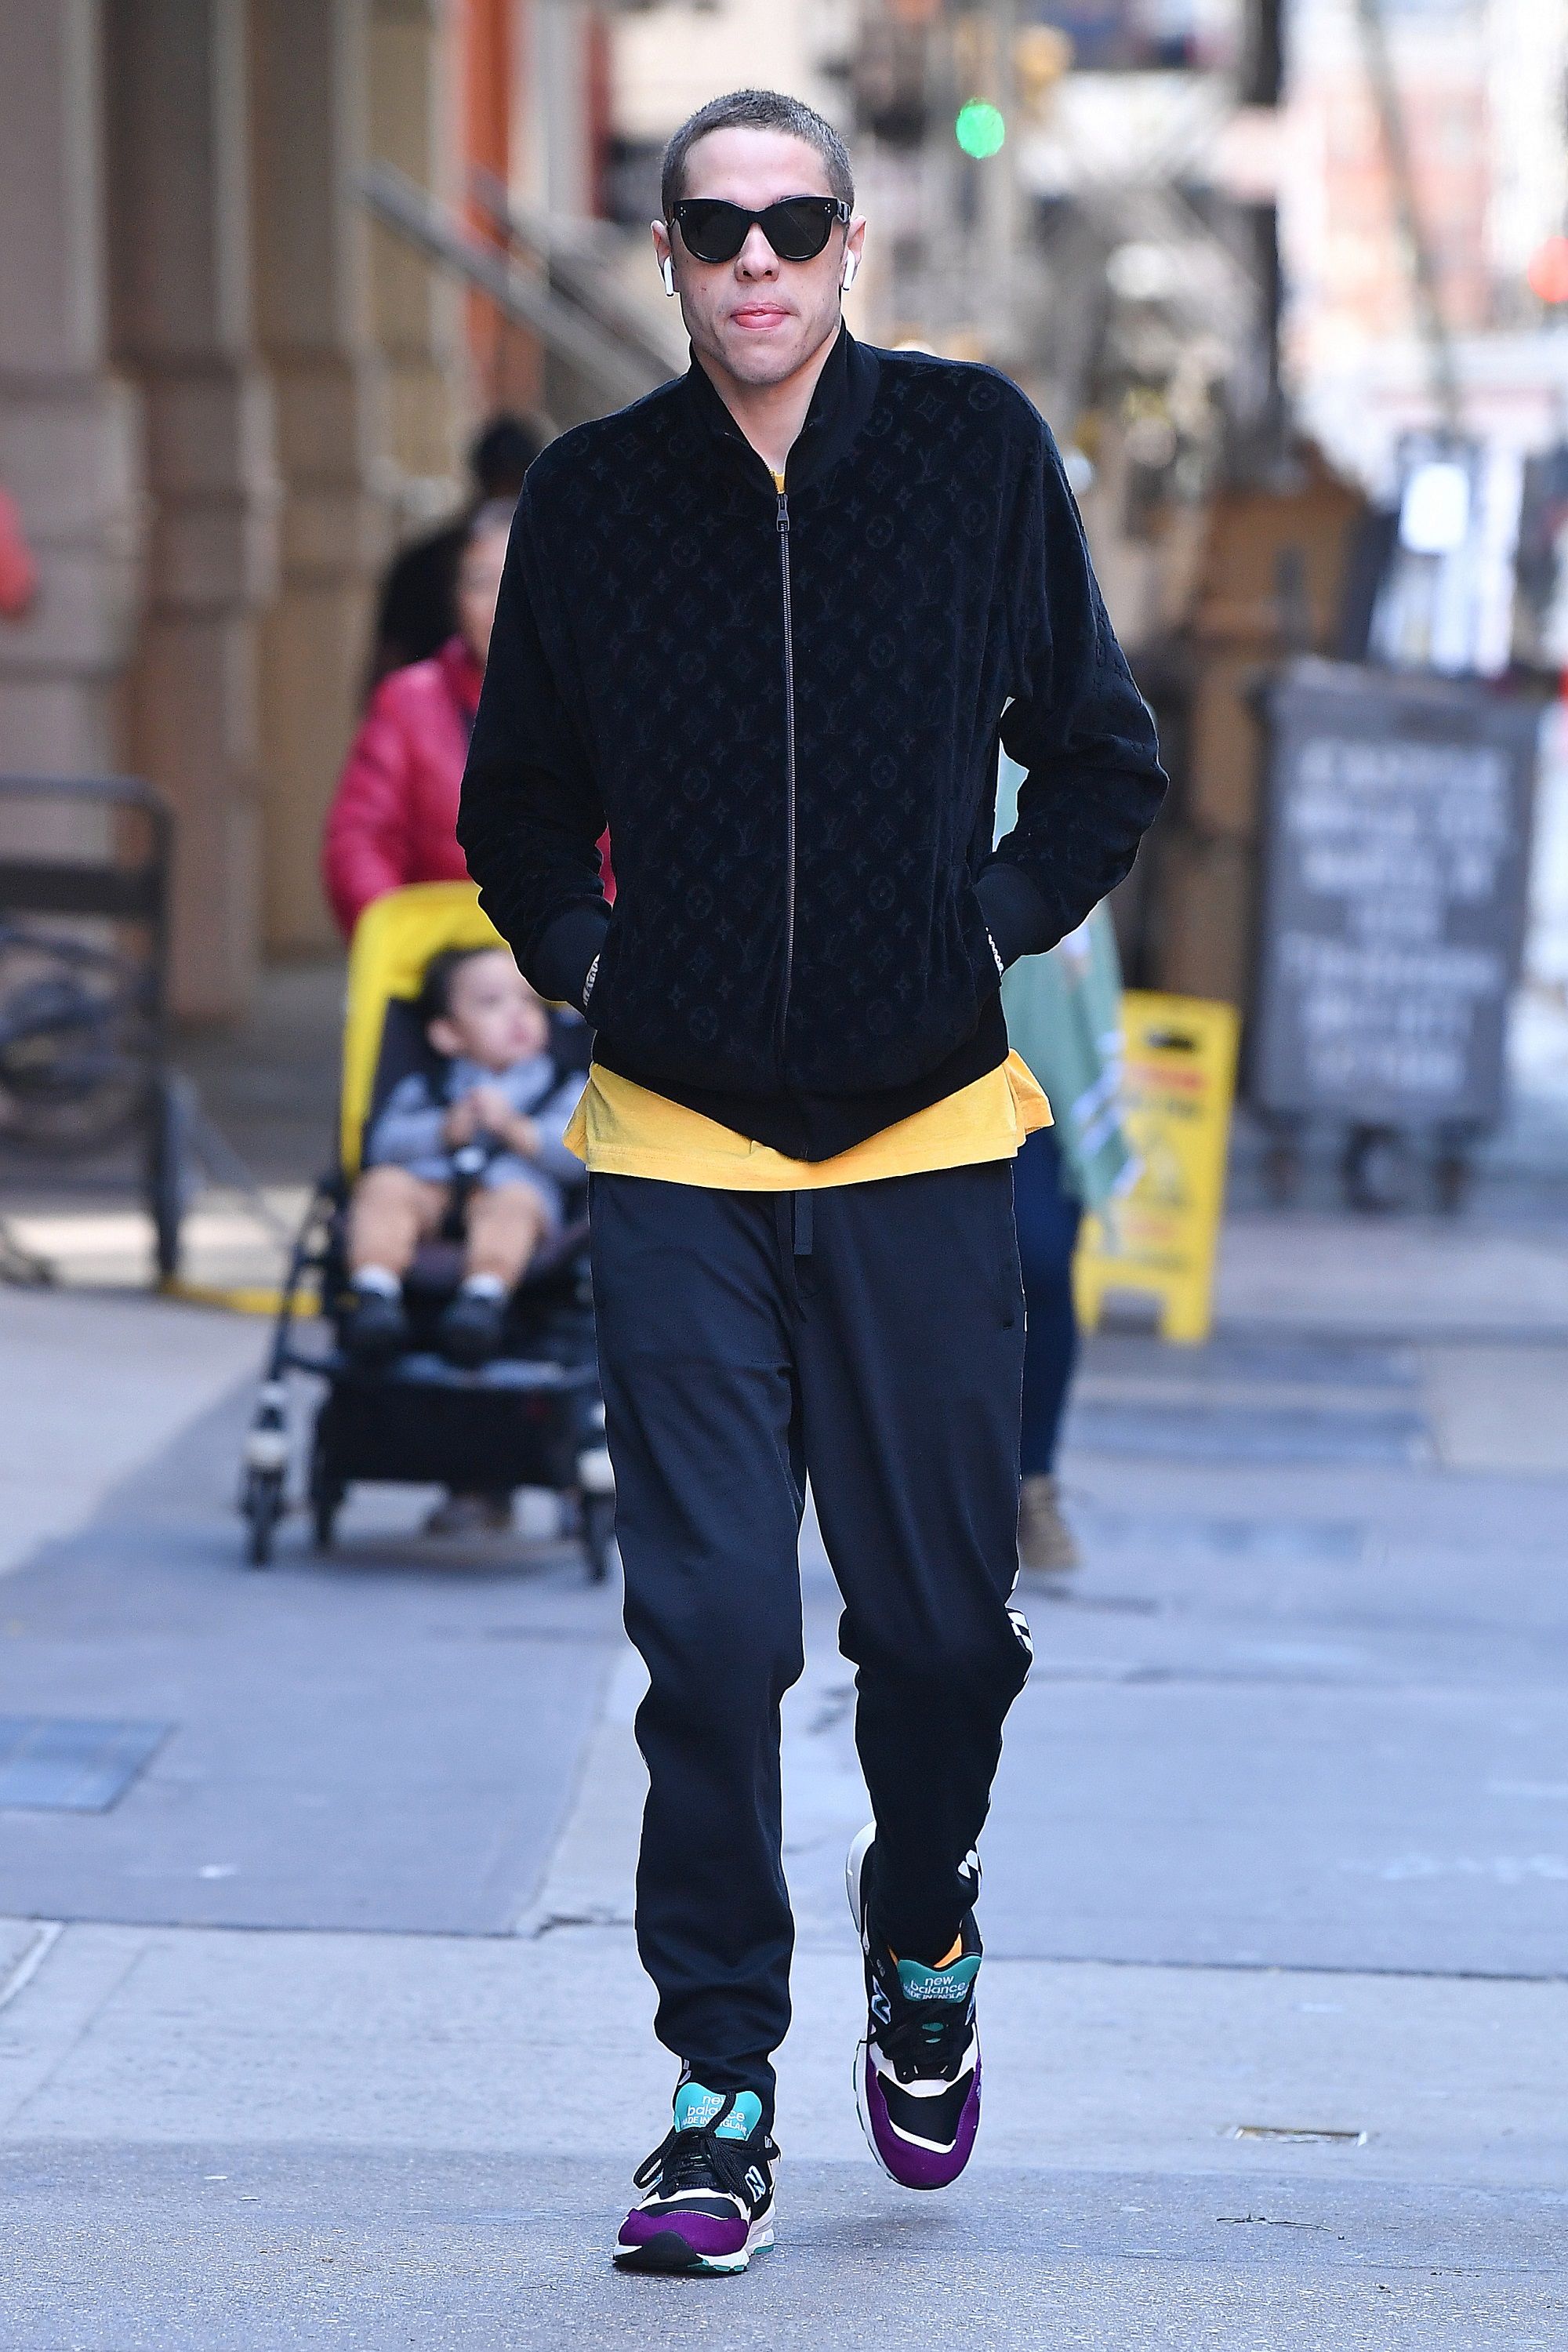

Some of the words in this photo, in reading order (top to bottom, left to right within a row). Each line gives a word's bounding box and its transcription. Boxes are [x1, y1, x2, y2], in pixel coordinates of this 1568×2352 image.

[910, 1980, 966, 1994] balance
[925, 1976, 954, 1987] new
[688, 2104, 745, 2122] balace
[744, 2165, 766, 2203] N
